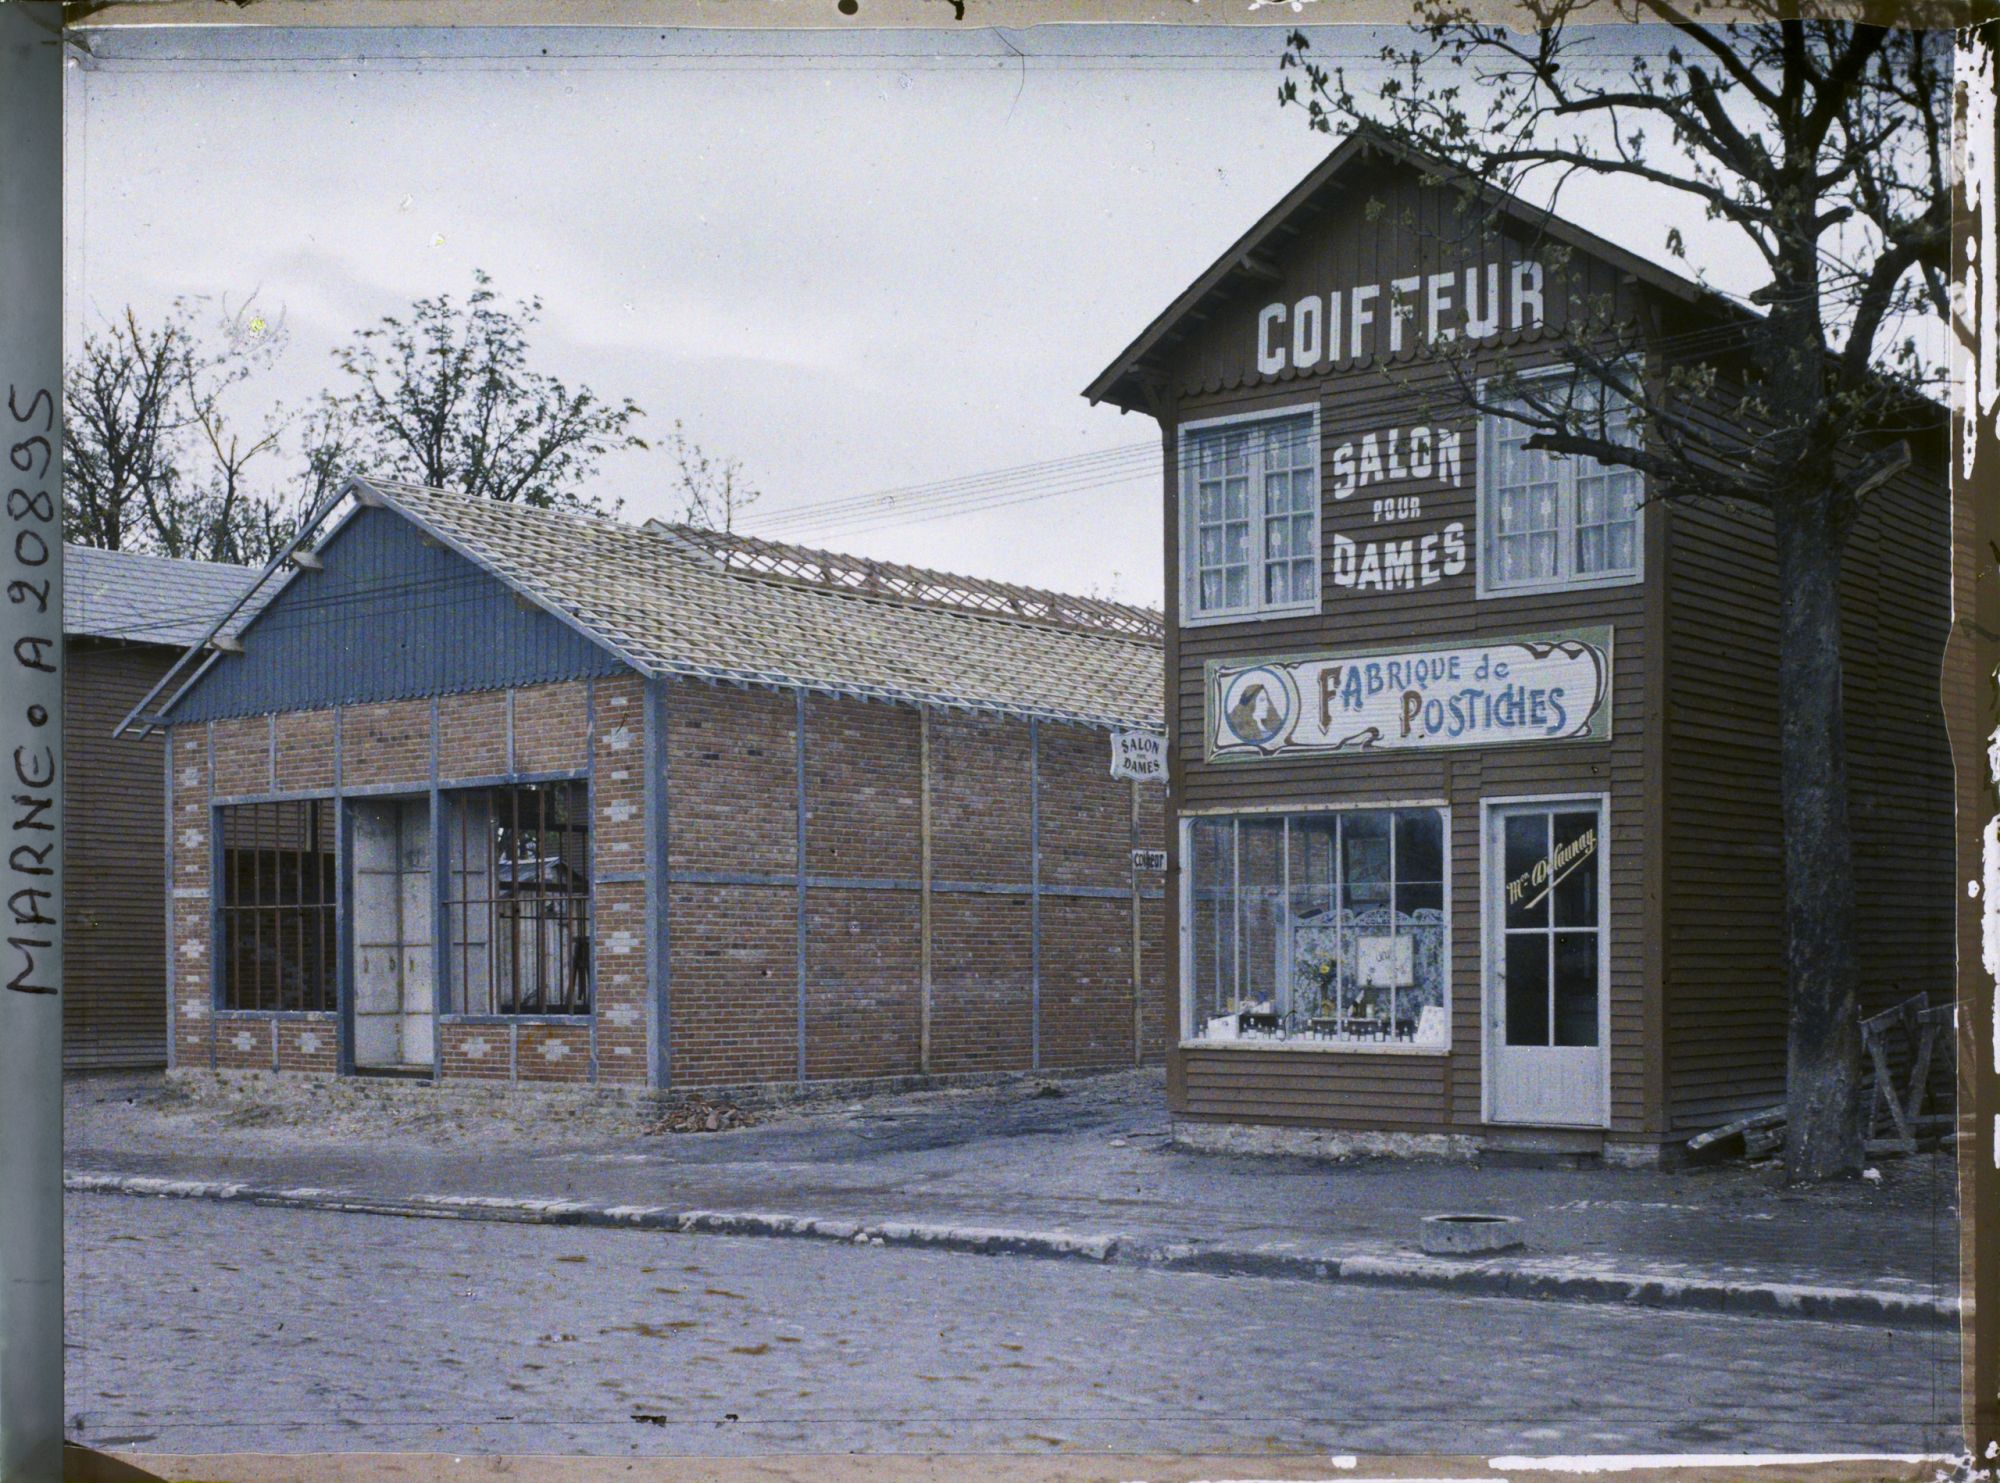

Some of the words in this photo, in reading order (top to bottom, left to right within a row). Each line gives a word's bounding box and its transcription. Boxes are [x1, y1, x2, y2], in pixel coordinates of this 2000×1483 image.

[1257, 260, 1544, 374] COIFFEUR
[1333, 427, 1461, 499] SALON
[1373, 496, 1421, 522] POUR
[1333, 523, 1466, 591] DAMES
[1317, 655, 1462, 737] FABRIQUE
[1475, 653, 1510, 680] de
[1400, 683, 1567, 738] POSTICHES
[1121, 738, 1160, 755] SALON
[1122, 757, 1161, 775] DAMES
